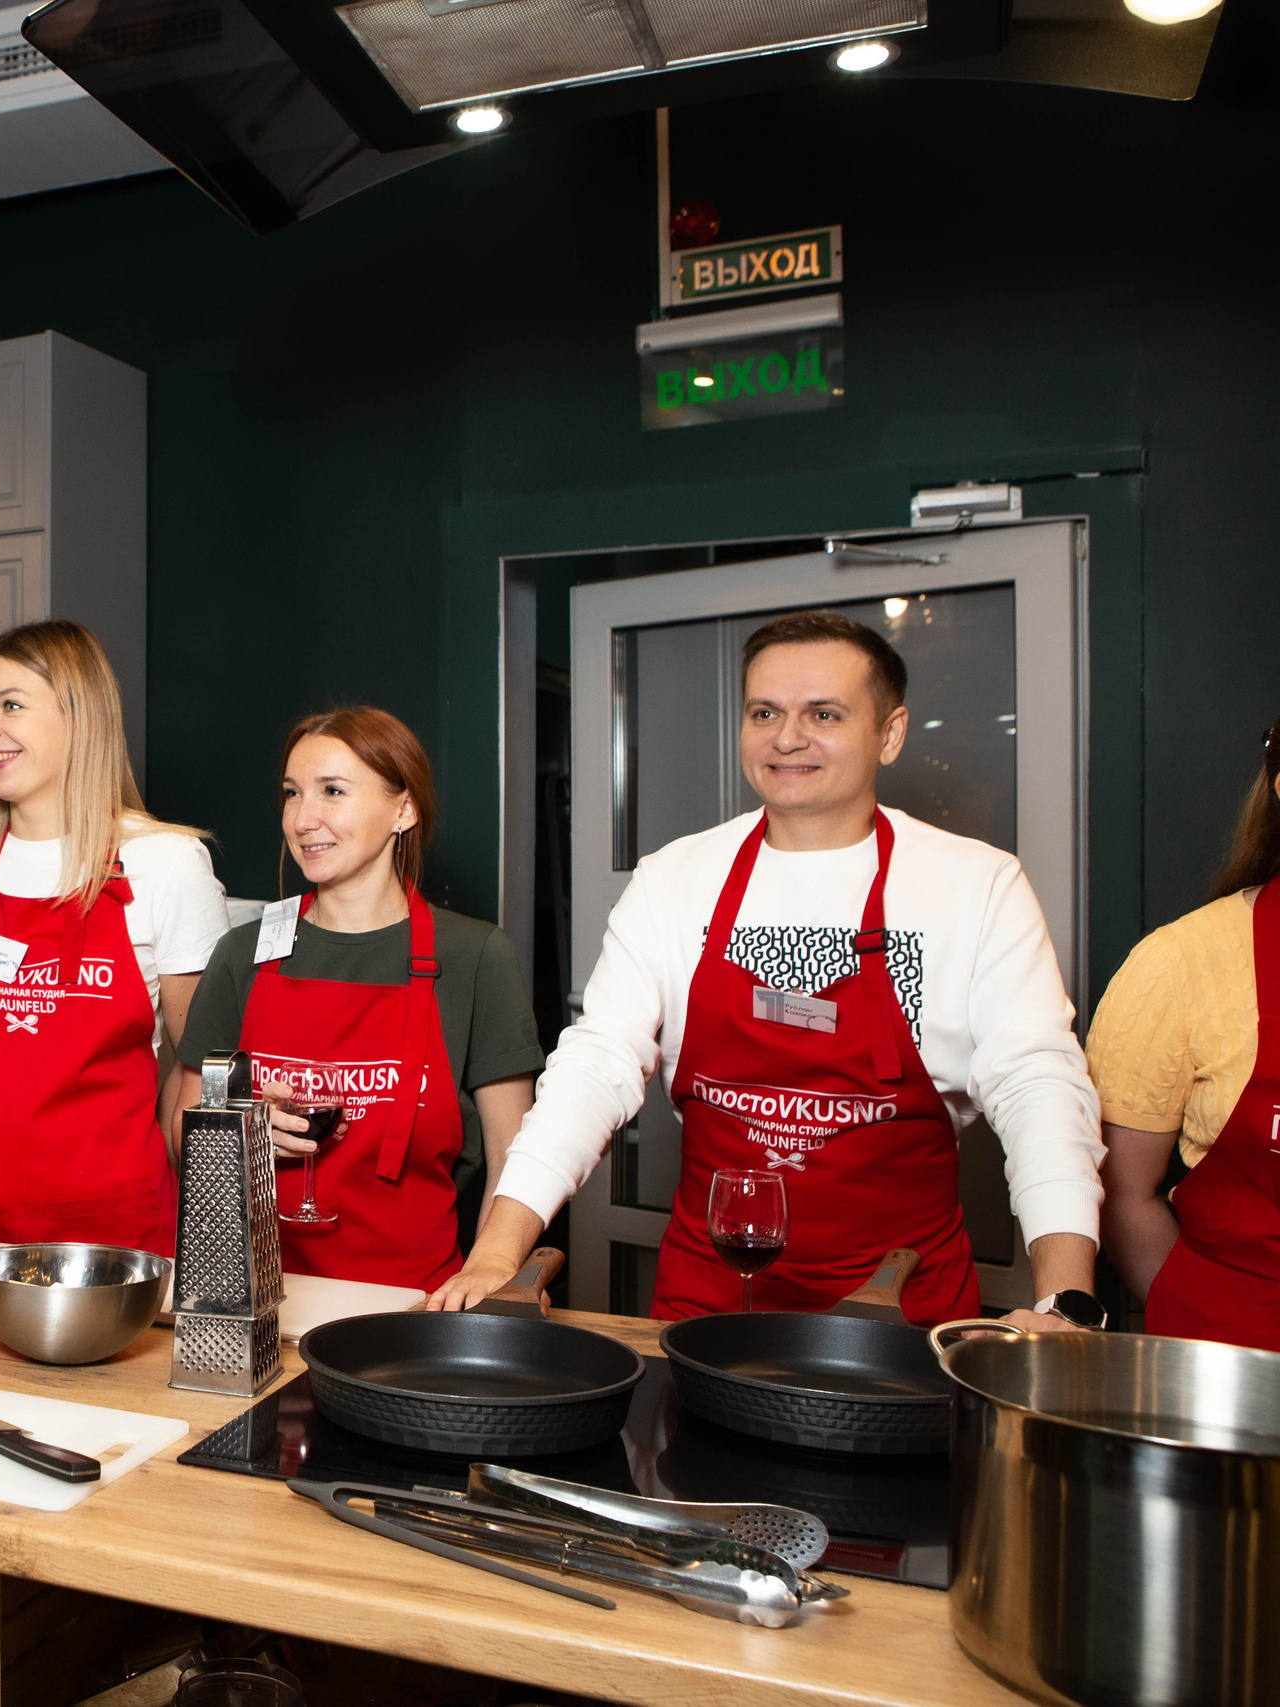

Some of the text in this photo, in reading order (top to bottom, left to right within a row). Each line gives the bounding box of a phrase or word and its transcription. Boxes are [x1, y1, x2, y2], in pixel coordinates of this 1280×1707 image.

[693, 242, 820, 291] ВЫХОД
[656, 348, 827, 410] ВЫХОД
[32, 988, 66, 1000] СТУДИЯ
[755, 990, 784, 1023] 1
[346, 1095, 378, 1106] СТУДИЯ
[748, 1127, 826, 1151] MAUNFELD
[798, 1126, 839, 1138] СТУДИЯ
